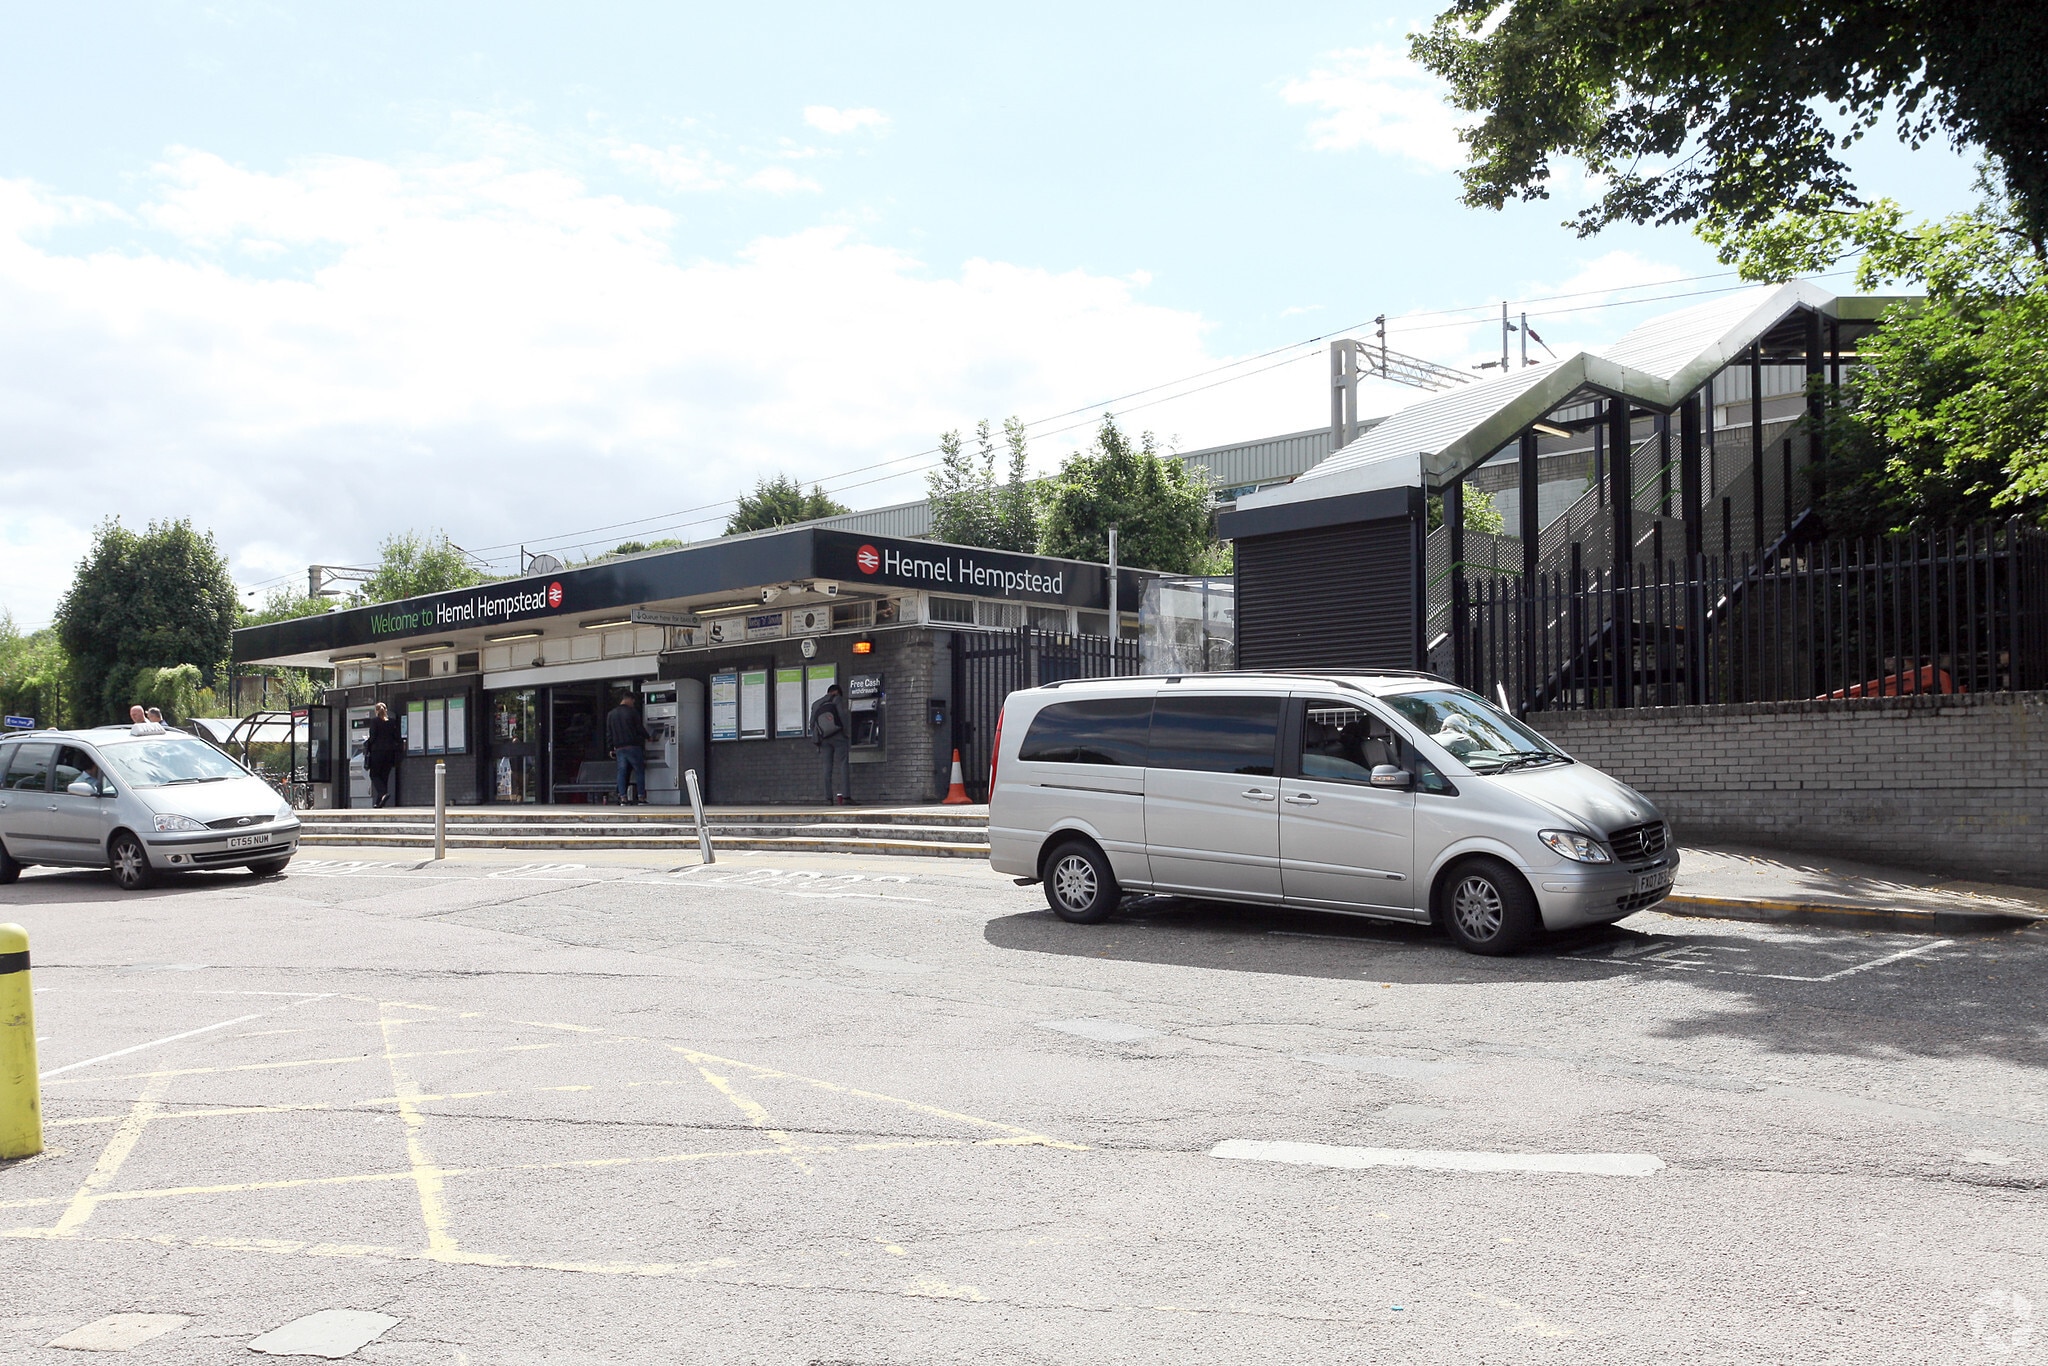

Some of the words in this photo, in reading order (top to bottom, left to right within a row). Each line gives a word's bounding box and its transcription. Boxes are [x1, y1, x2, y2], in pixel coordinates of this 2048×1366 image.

[885, 549, 953, 582] Hemel
[959, 558, 1063, 596] Hempstead
[370, 612, 418, 634] Welcome
[422, 609, 433, 627] to
[436, 598, 475, 624] Hemel
[478, 585, 547, 620] Hempstead
[850, 679, 864, 688] Free
[864, 678, 881, 687] Cash
[230, 836, 253, 847] CT55
[253, 834, 269, 845] NUM
[1640, 874, 1657, 890] FX07
